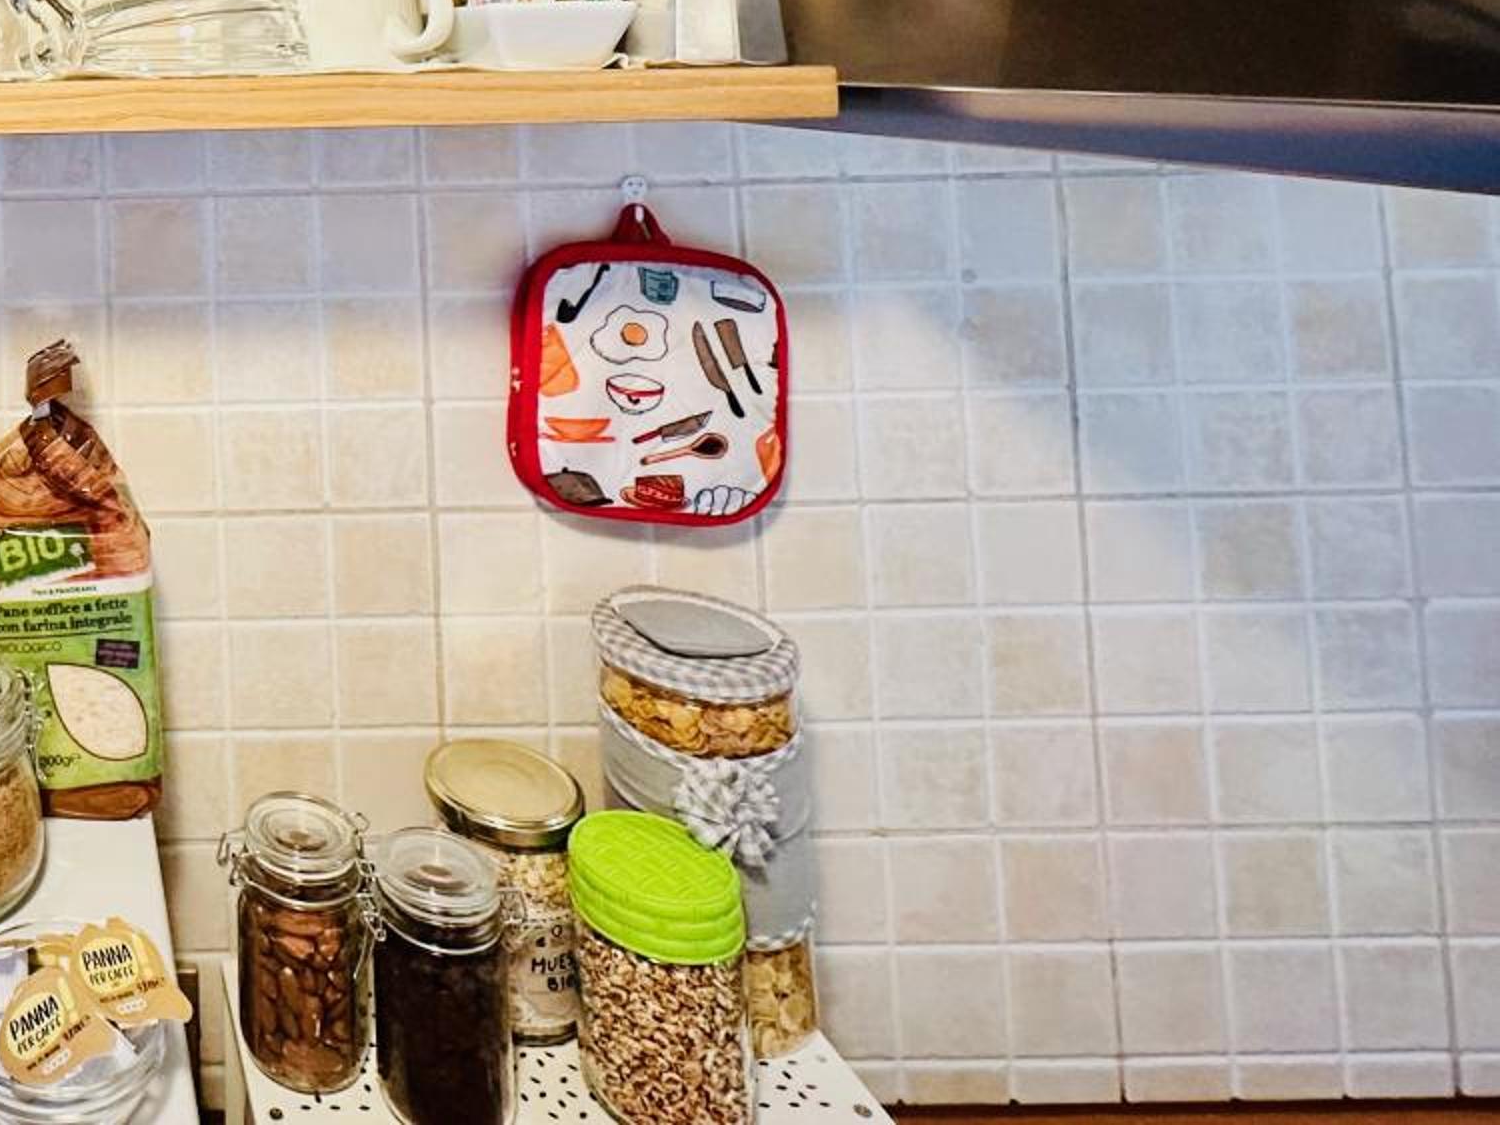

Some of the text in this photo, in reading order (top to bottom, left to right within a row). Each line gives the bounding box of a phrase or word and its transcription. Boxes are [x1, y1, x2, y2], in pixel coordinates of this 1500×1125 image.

[33, 601, 80, 617] soffice
[84, 603, 93, 613] a
[96, 598, 129, 612] fette
[23, 617, 68, 633] farina
[70, 611, 133, 630] integrale
[82, 943, 133, 972] PANNA
[9, 994, 60, 1041] PANNA
